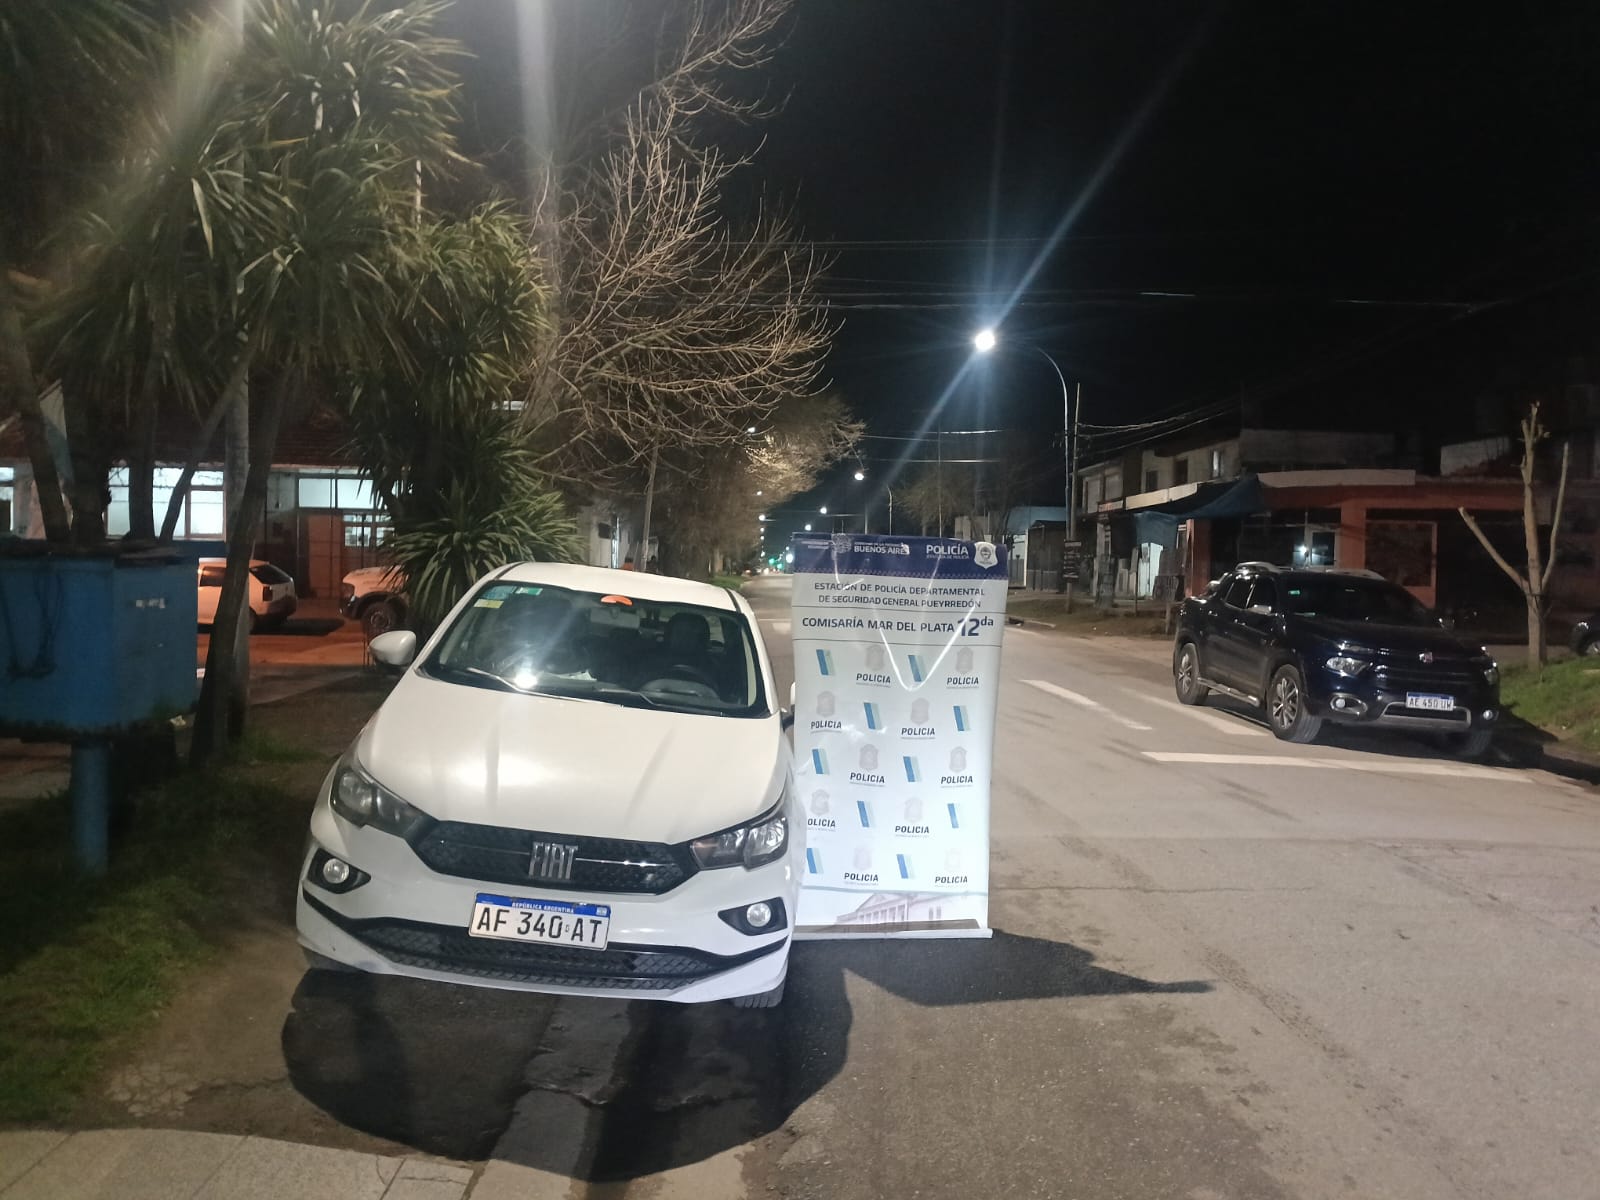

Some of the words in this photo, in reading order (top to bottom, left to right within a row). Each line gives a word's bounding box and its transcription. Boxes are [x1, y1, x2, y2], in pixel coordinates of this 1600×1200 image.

[854, 545, 887, 554] BUENOS
[926, 544, 969, 555] POLICÍA
[814, 582, 857, 591] ESTACIÓN
[875, 584, 907, 594] POLICÍA
[909, 586, 985, 596] DEPARTAMENTAL
[818, 595, 830, 603] DE
[832, 596, 881, 605] SEGURIDAD
[882, 597, 920, 607] GENERAL
[921, 598, 982, 608] PUEYRREDÓN
[802, 615, 864, 628] COMISARÍA
[868, 619, 893, 630] MAR
[896, 621, 916, 632] DEL
[920, 622, 955, 633] PLATA
[856, 673, 891, 684] POLICIA
[946, 676, 979, 685] POLICIA
[810, 720, 842, 729] POLICIA
[901, 727, 936, 736] POLICIA
[849, 772, 885, 784] POLICIA
[940, 775, 973, 785] POLICIA
[807, 818, 836, 828] OLICIA
[894, 825, 930, 834] POLICIA
[528, 841, 579, 880] FIAT
[844, 872, 879, 882] POLICIA
[934, 875, 968, 884] POLICIA
[477, 907, 510, 932] AF
[517, 911, 563, 939] 340
[571, 917, 602, 943] AT
